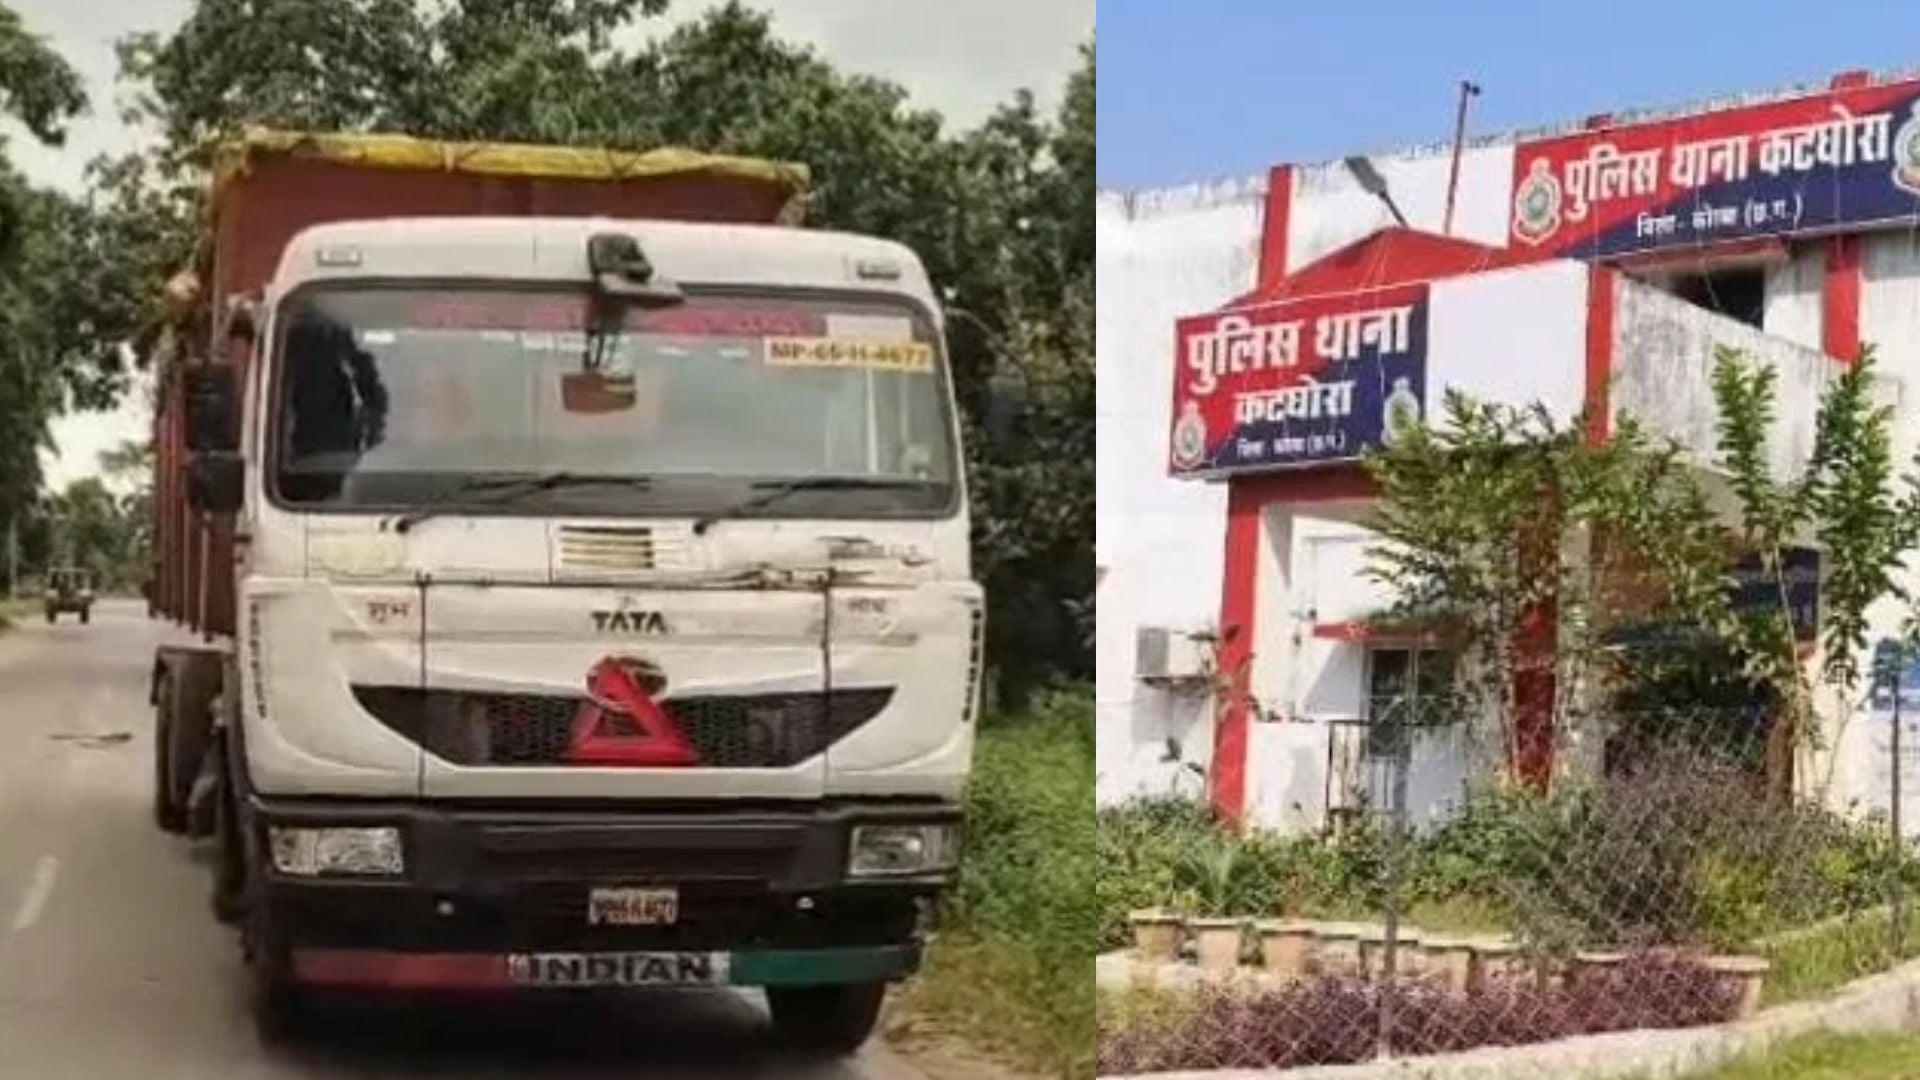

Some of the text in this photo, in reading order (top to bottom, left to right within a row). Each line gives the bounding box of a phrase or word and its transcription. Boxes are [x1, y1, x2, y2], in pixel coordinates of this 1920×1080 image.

[1562, 104, 1892, 223] पुलिस थाना कटघोरा
[1185, 305, 1413, 395] पुलिस थाना
[1232, 373, 1356, 425] कटघोरा
[590, 610, 668, 634] TATA
[528, 955, 712, 982] INDIAN
